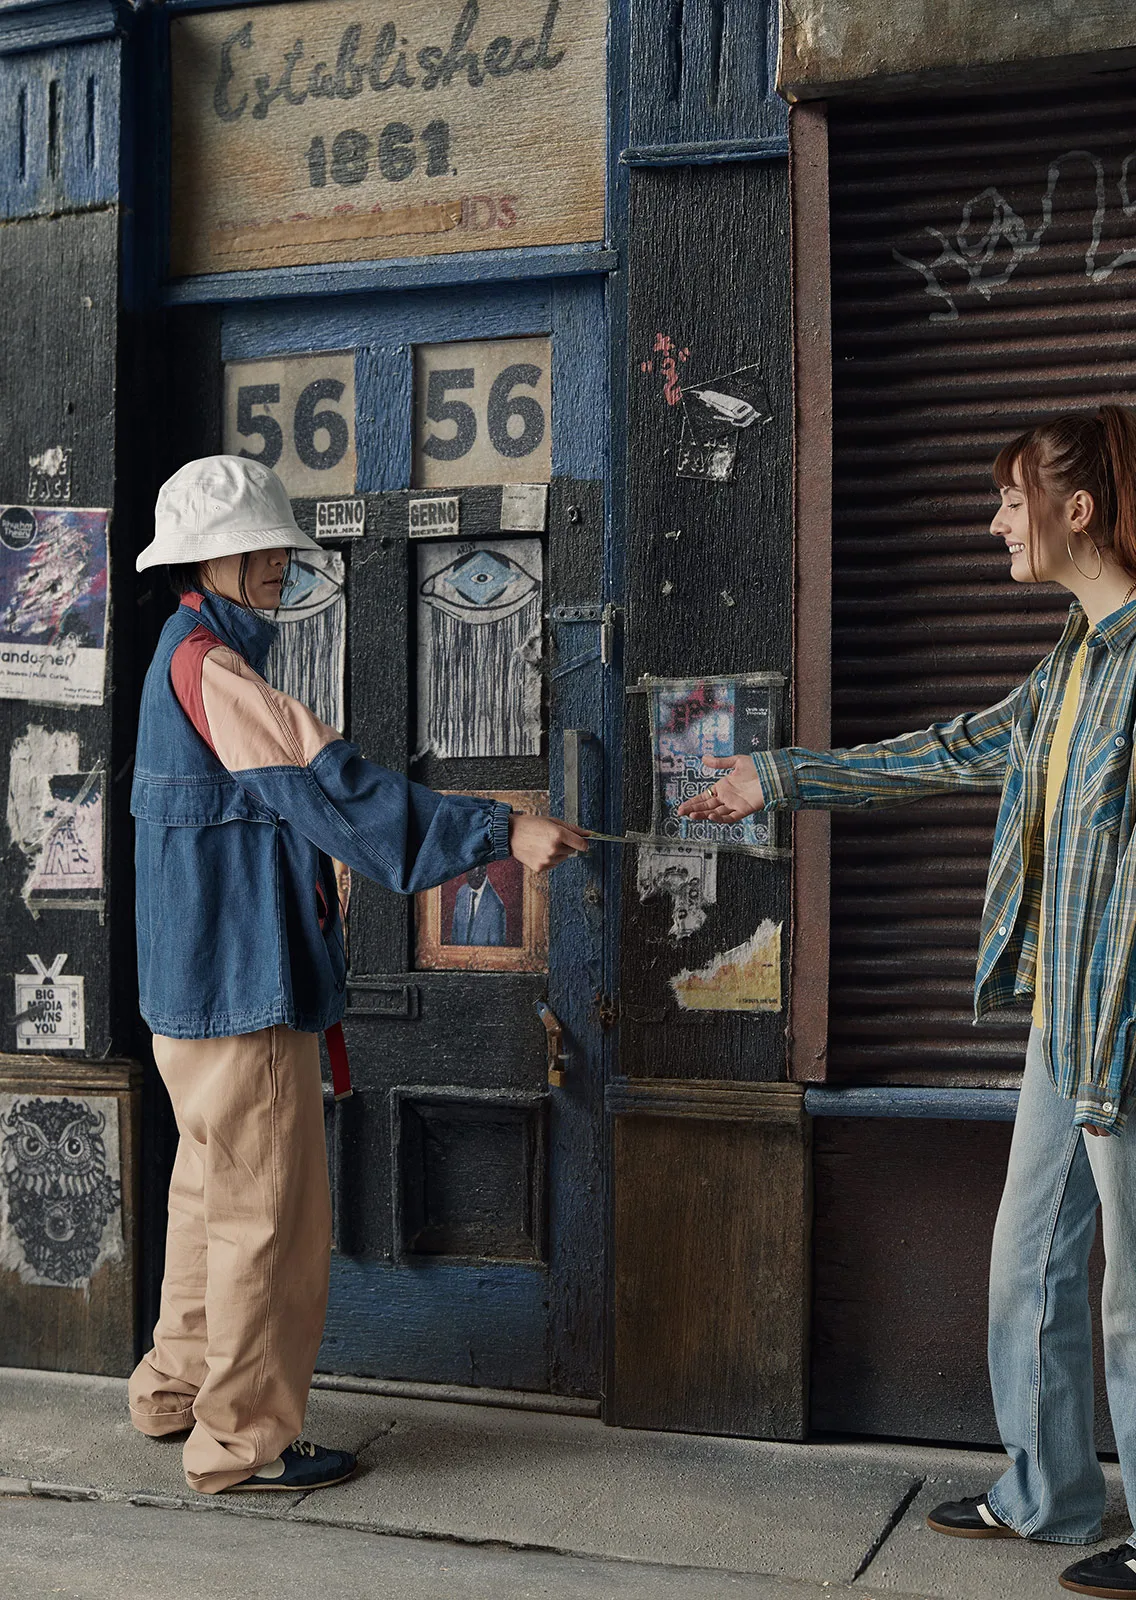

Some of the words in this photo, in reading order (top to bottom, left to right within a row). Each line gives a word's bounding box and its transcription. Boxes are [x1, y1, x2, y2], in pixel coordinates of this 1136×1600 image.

[213, 0, 566, 122] Established
[236, 378, 349, 470] 56
[422, 363, 546, 462] 56
[317, 501, 364, 527] GERNO
[410, 500, 457, 528] GERNO
[35, 989, 54, 1000] BIG
[34, 1023, 57, 1034] YOU
